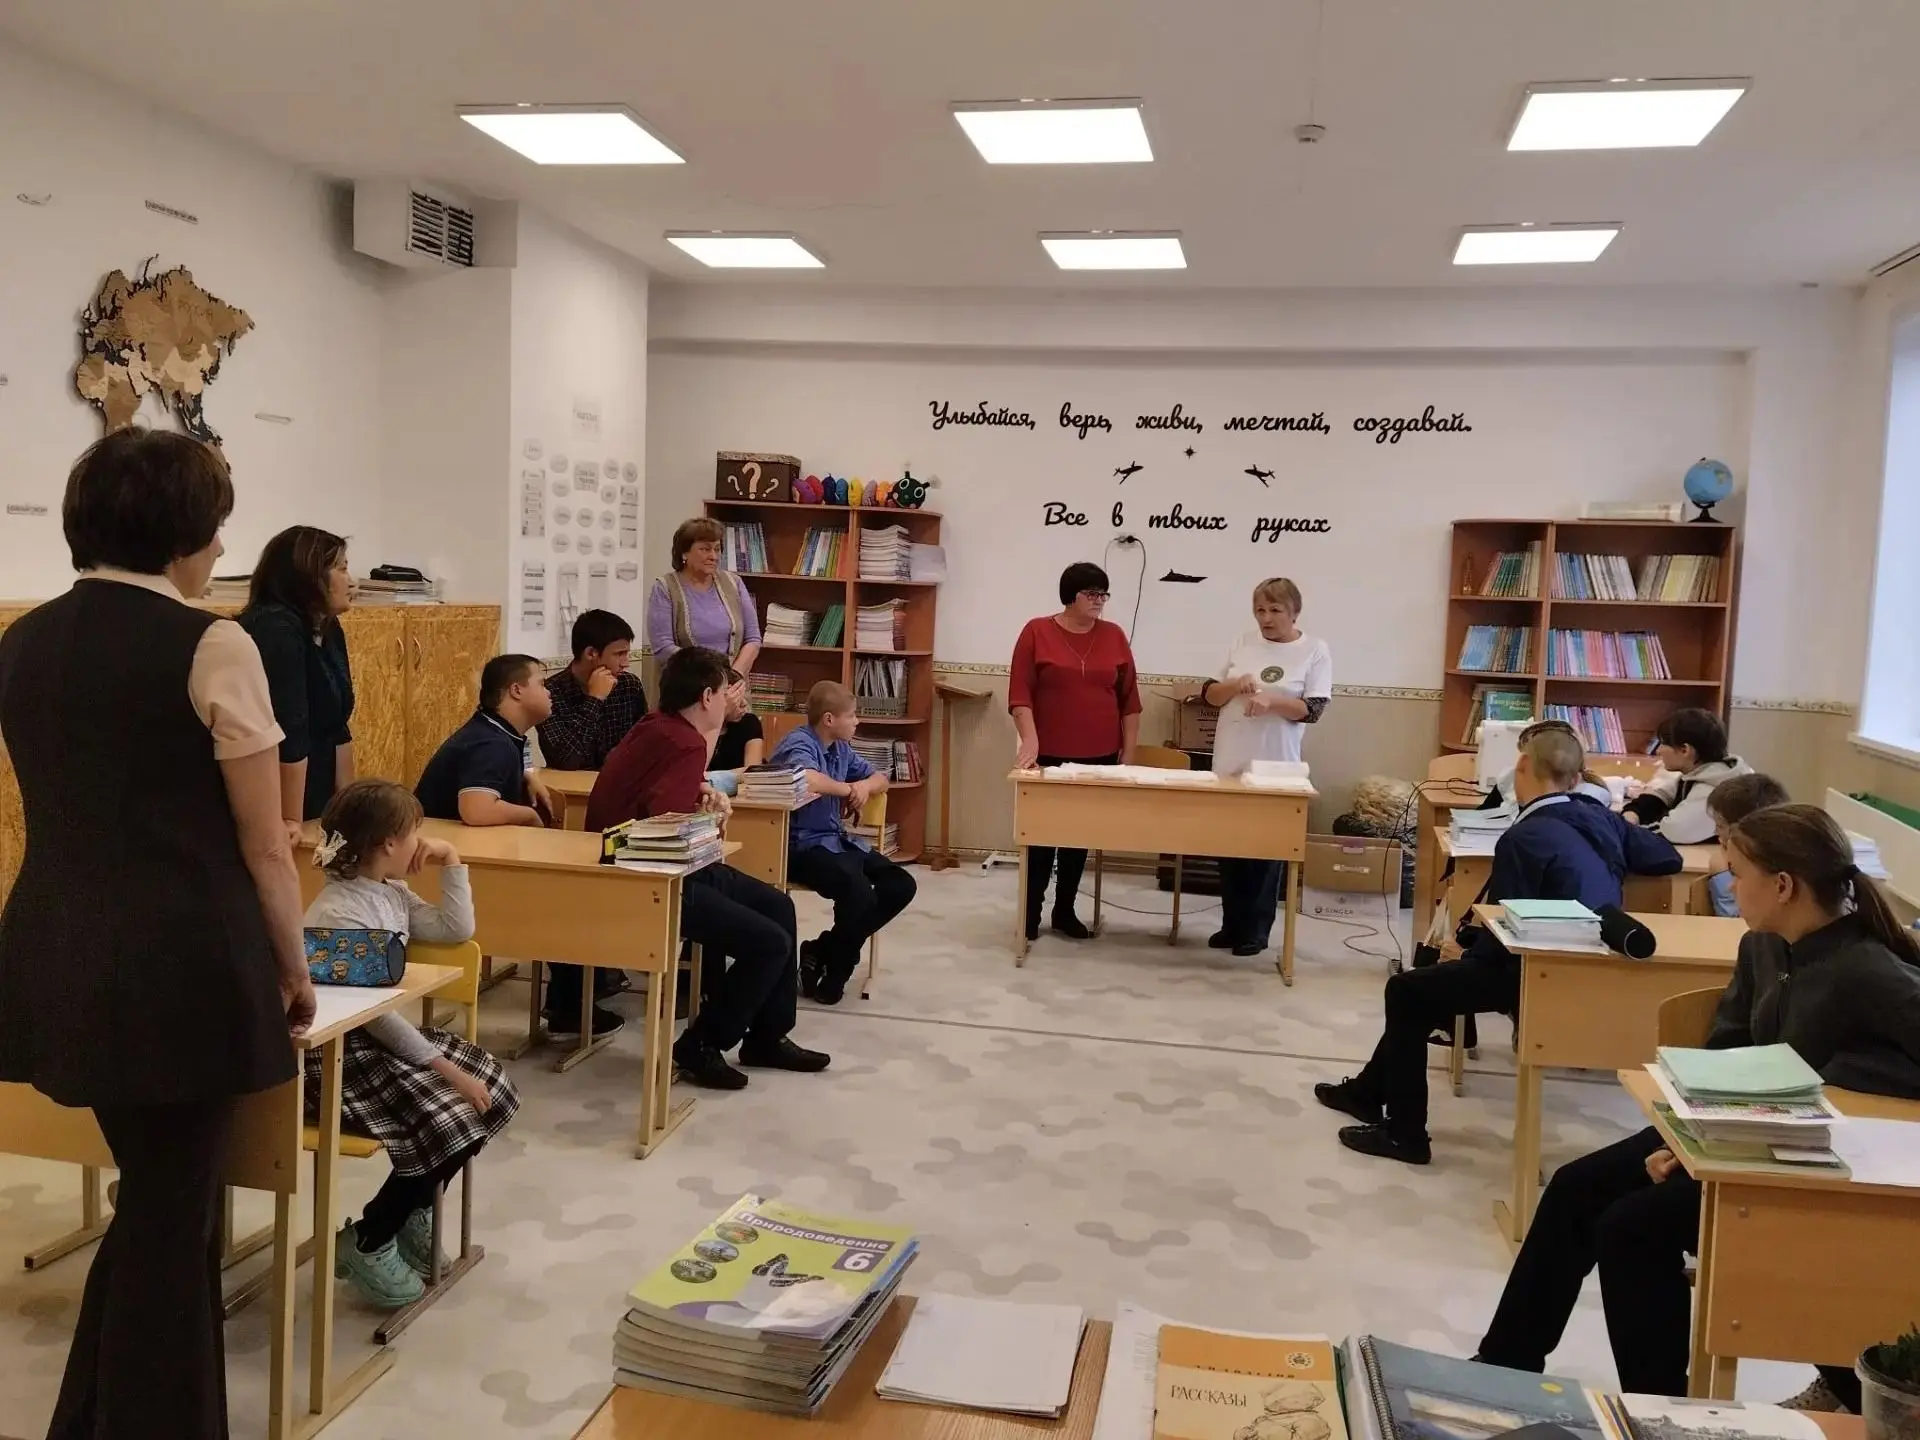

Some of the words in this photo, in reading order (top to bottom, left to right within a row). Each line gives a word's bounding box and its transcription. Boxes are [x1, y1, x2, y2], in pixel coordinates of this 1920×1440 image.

[928, 400, 1036, 431] Улыбайся,
[1059, 401, 1113, 441] верь,
[1135, 403, 1204, 435] живи,
[1223, 411, 1331, 436] мечтай,
[1352, 404, 1473, 445] создавай.
[1042, 501, 1090, 527] Все
[1111, 501, 1124, 528] в
[1148, 502, 1228, 531] твоих
[1250, 517, 1332, 544] руках
[738, 1211, 890, 1250] Природоведение
[843, 1252, 875, 1271] 6
[1170, 1383, 1248, 1408] РАССКАЗЫ
